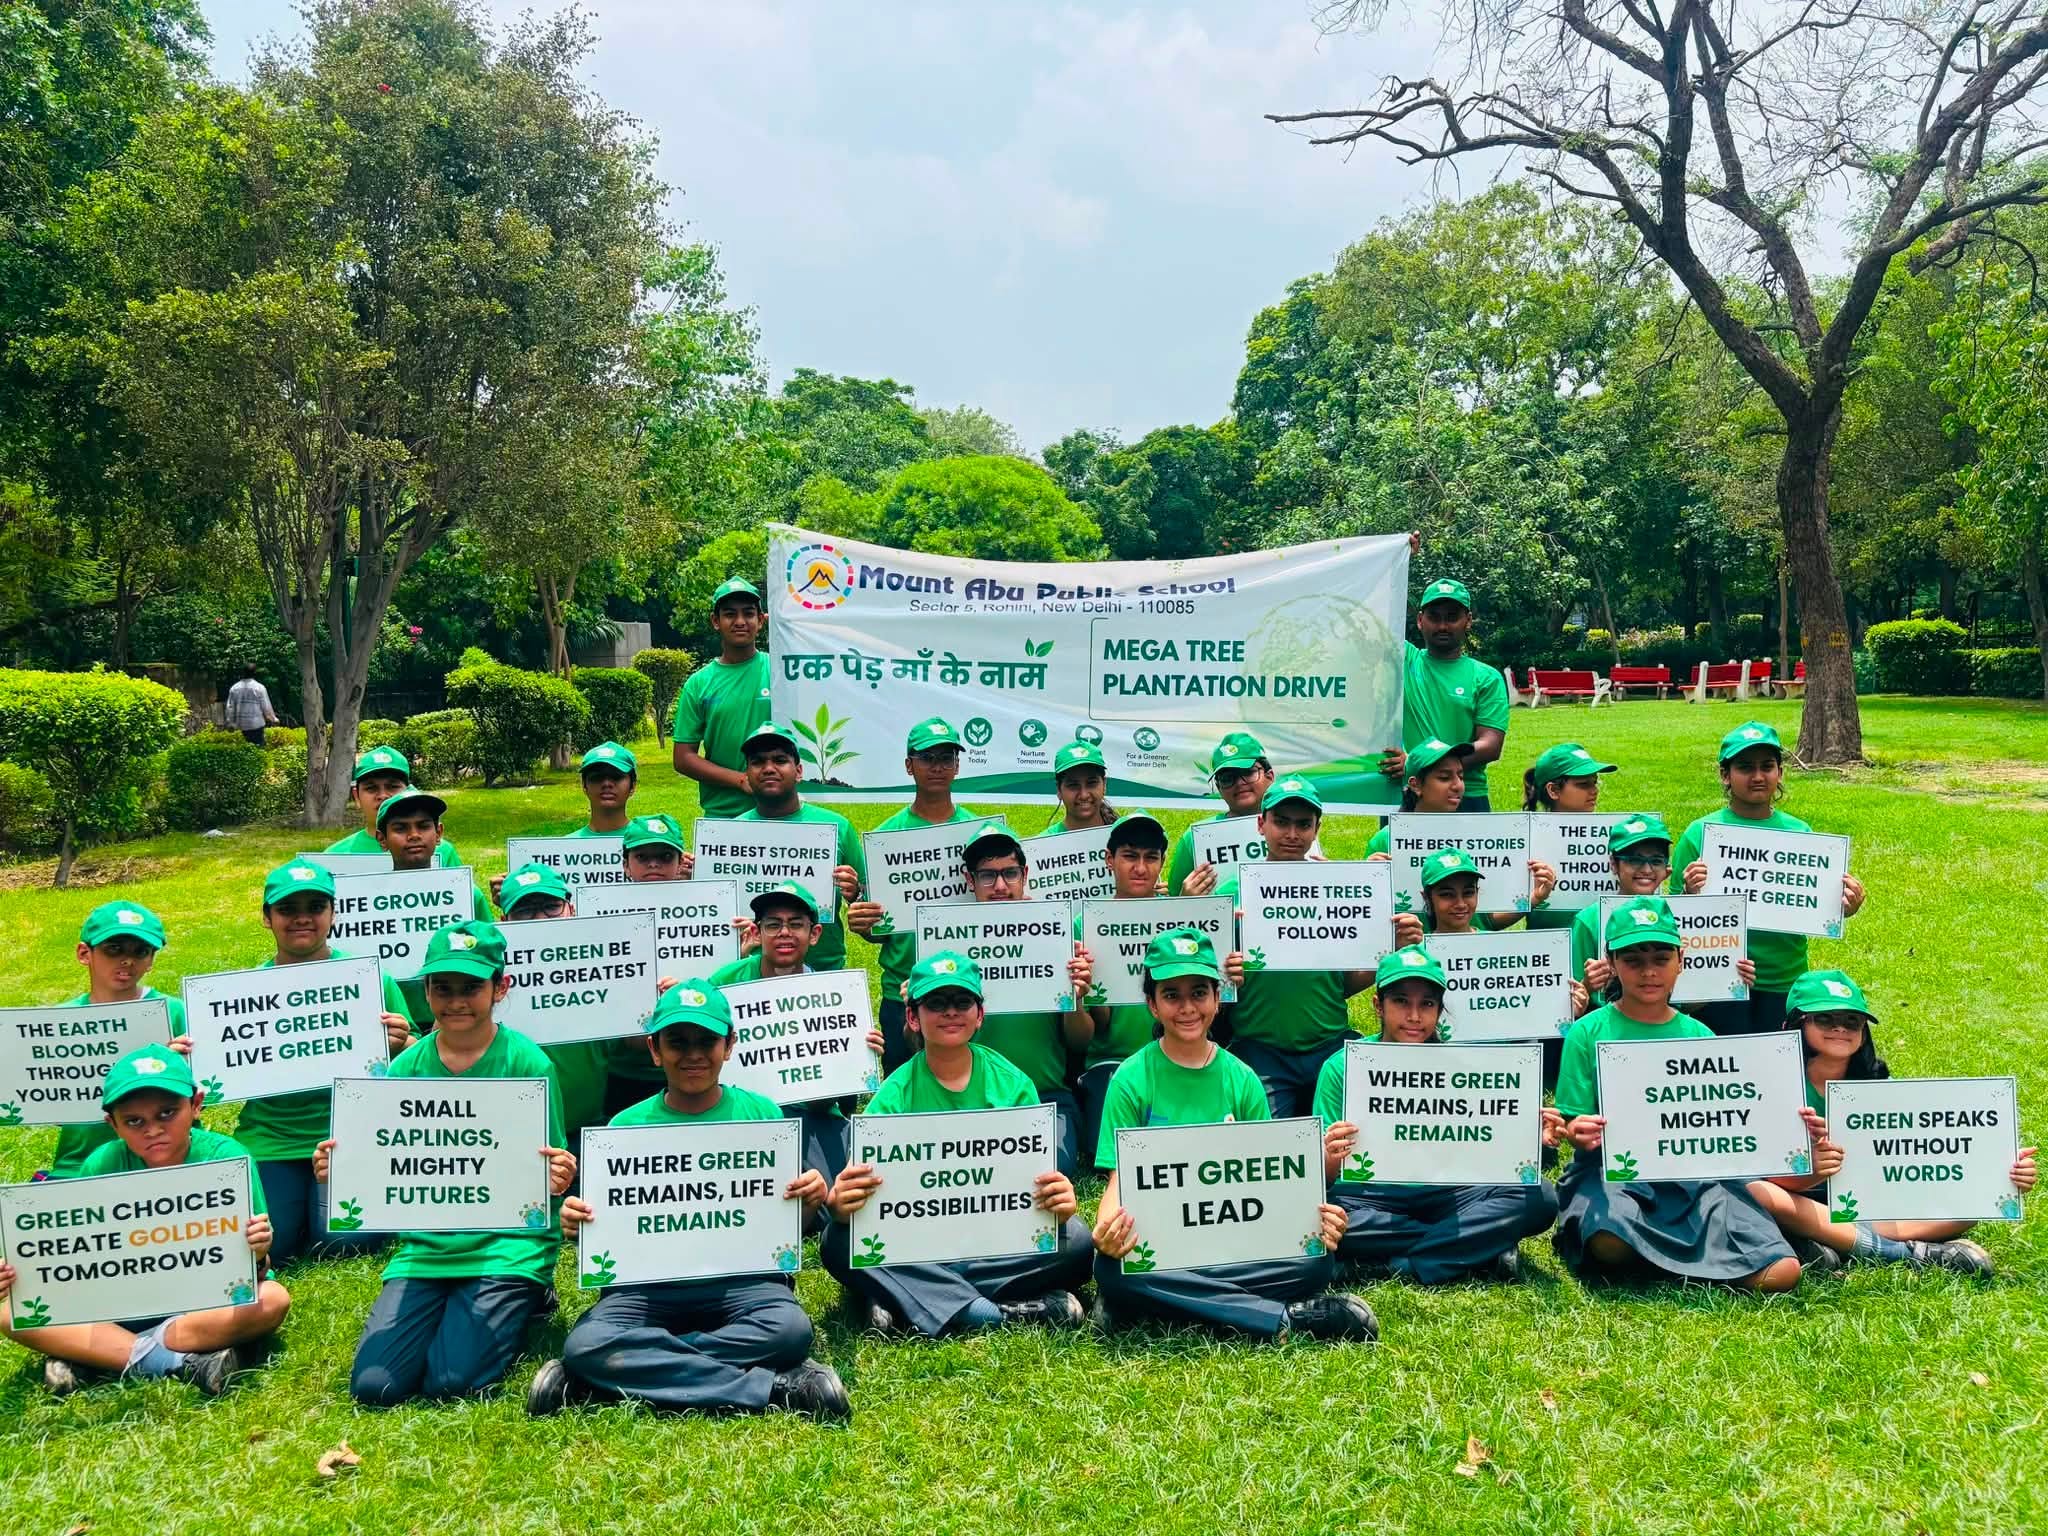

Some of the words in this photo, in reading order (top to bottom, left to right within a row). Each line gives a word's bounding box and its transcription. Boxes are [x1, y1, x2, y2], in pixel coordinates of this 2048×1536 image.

[859, 565, 954, 594] Mount
[965, 579, 1024, 600] Abu
[1138, 578, 1235, 596] School
[910, 600, 959, 612] Sector
[1042, 600, 1075, 613] New
[1082, 600, 1121, 613] Delhi
[1141, 600, 1195, 614] 110085
[1103, 639, 1180, 661] MEGA
[1186, 640, 1245, 662] TREE
[782, 654, 835, 681] एक
[840, 648, 884, 689] पेड़
[890, 648, 934, 682] माँ
[938, 652, 972, 686] के
[978, 662, 1047, 689] नाम
[1103, 674, 1266, 697] PLANTATION
[1274, 676, 1346, 697] DRIVE
[968, 757, 987, 765] Today
[1559, 826, 1587, 838] THE
[700, 844, 727, 856] THE
[730, 845, 767, 857] BEST
[769, 847, 830, 860] STORIES
[1395, 838, 1423, 850] THE
[1427, 838, 1463, 850] BEST
[1466, 838, 1525, 850] STORIES
[1568, 844, 1610, 855] BLOO
[532, 854, 560, 866] THE
[564, 853, 621, 865] WORLD
[884, 848, 941, 866] WHERE
[1036, 852, 1085, 871] WHERE
[1206, 845, 1240, 865] LET
[1471, 856, 1498, 867] ITH
[1501, 856, 1512, 867] A
[1719, 845, 1769, 862] THINK
[1774, 851, 1829, 869] GREEN
[713, 863, 757, 875] BEGIN
[761, 864, 800, 877] WITH
[804, 865, 815, 877] A
[888, 867, 945, 885] GROW,
[1560, 862, 1610, 873] THROU
[1722, 866, 1758, 881] ACT
[1762, 871, 1817, 888] GREEN
[1029, 871, 1085, 890] DEEPEN,
[373, 890, 454, 911] GROWS
[904, 883, 972, 903] FOLLOW
[1260, 886, 1319, 899] WHERE
[1323, 886, 1372, 898] TREES
[1762, 891, 1817, 909] GREEN
[661, 905, 718, 919] ROOTS
[1263, 906, 1322, 920] GROW,
[1326, 906, 1371, 919] HOPE
[658, 924, 730, 939] FUTURES
[924, 926, 979, 940] PLANT
[983, 922, 1066, 938] PURPOSE,
[1097, 923, 1151, 936] GREEN
[1278, 926, 1358, 939] FOLLOWS
[379, 943, 410, 959] DO
[504, 950, 535, 965] LET
[540, 944, 603, 962] GREEN
[609, 941, 631, 956] BE
[968, 944, 1023, 959] GROW
[1448, 958, 1473, 971] LET
[1477, 955, 1527, 970] GREEN
[1532, 954, 1550, 967] BE
[550, 962, 647, 984] GREATEST
[1447, 978, 1480, 991] OUR
[1484, 974, 1562, 989] GREATEST
[209, 994, 281, 1018] THINK
[286, 984, 360, 1007] GREEN
[531, 989, 608, 1010] LEGACY
[735, 1000, 772, 1019] THE
[776, 992, 842, 1013] WORLD
[1469, 995, 1531, 1010] LEGACY
[16, 1023, 54, 1038] THE
[59, 1018, 127, 1036] EARTH
[221, 1020, 269, 1043] ACT
[275, 1010, 349, 1035] GREEN
[737, 1020, 799, 1043] ROWS
[803, 1014, 857, 1032] WISER
[32, 1041, 119, 1059] BLOOMS
[225, 1046, 273, 1068] LIVE
[279, 1035, 353, 1059] GREEN
[739, 1045, 791, 1067] WITH
[795, 1037, 850, 1058] EVERY
[26, 1064, 114, 1080] THROUG
[778, 1064, 823, 1085] TREE
[1666, 1056, 1740, 1075] SMALL
[1368, 1070, 1445, 1088] WHERE
[1451, 1072, 1520, 1089] GREEN
[16, 1088, 72, 1102] YOUR
[1645, 1082, 1762, 1103] SAPLINGS,
[400, 1100, 477, 1118] SMALL
[1369, 1097, 1473, 1118] REMAINS,
[1480, 1099, 1518, 1115] LIFE
[1661, 1109, 1750, 1129] MIGHTY
[1846, 1112, 1913, 1130] GREEN
[1919, 1110, 1998, 1128] SPEAKS
[376, 1128, 499, 1149] SAPLINGS,
[1394, 1124, 1492, 1142] REMAINS
[862, 1143, 936, 1163] PLANT
[942, 1135, 1047, 1159] PURPOSE,
[1658, 1136, 1757, 1156] FUTURES
[1873, 1137, 1972, 1156] WITHOUT
[391, 1157, 486, 1175] MIGHTY
[607, 1154, 692, 1176] WHERE
[699, 1150, 776, 1170] GREEN
[1135, 1162, 1189, 1191] LET
[1197, 1154, 1305, 1185] GREEN
[920, 1167, 993, 1189] GROW
[1883, 1164, 1963, 1182] WORDS
[386, 1186, 490, 1204] FUTURES
[608, 1182, 724, 1207] REMAINS,
[731, 1179, 774, 1198] LIFE
[15, 1205, 105, 1231] GREEN
[112, 1188, 236, 1221] CHOICES
[880, 1192, 1031, 1220] POSSIBILITIES
[1182, 1198, 1264, 1228] LEAD
[637, 1209, 746, 1234] REMAINS
[16, 1232, 122, 1259] CREATE
[129, 1215, 239, 1248] GOLDEN
[37, 1245, 224, 1284] TOMORROWS
